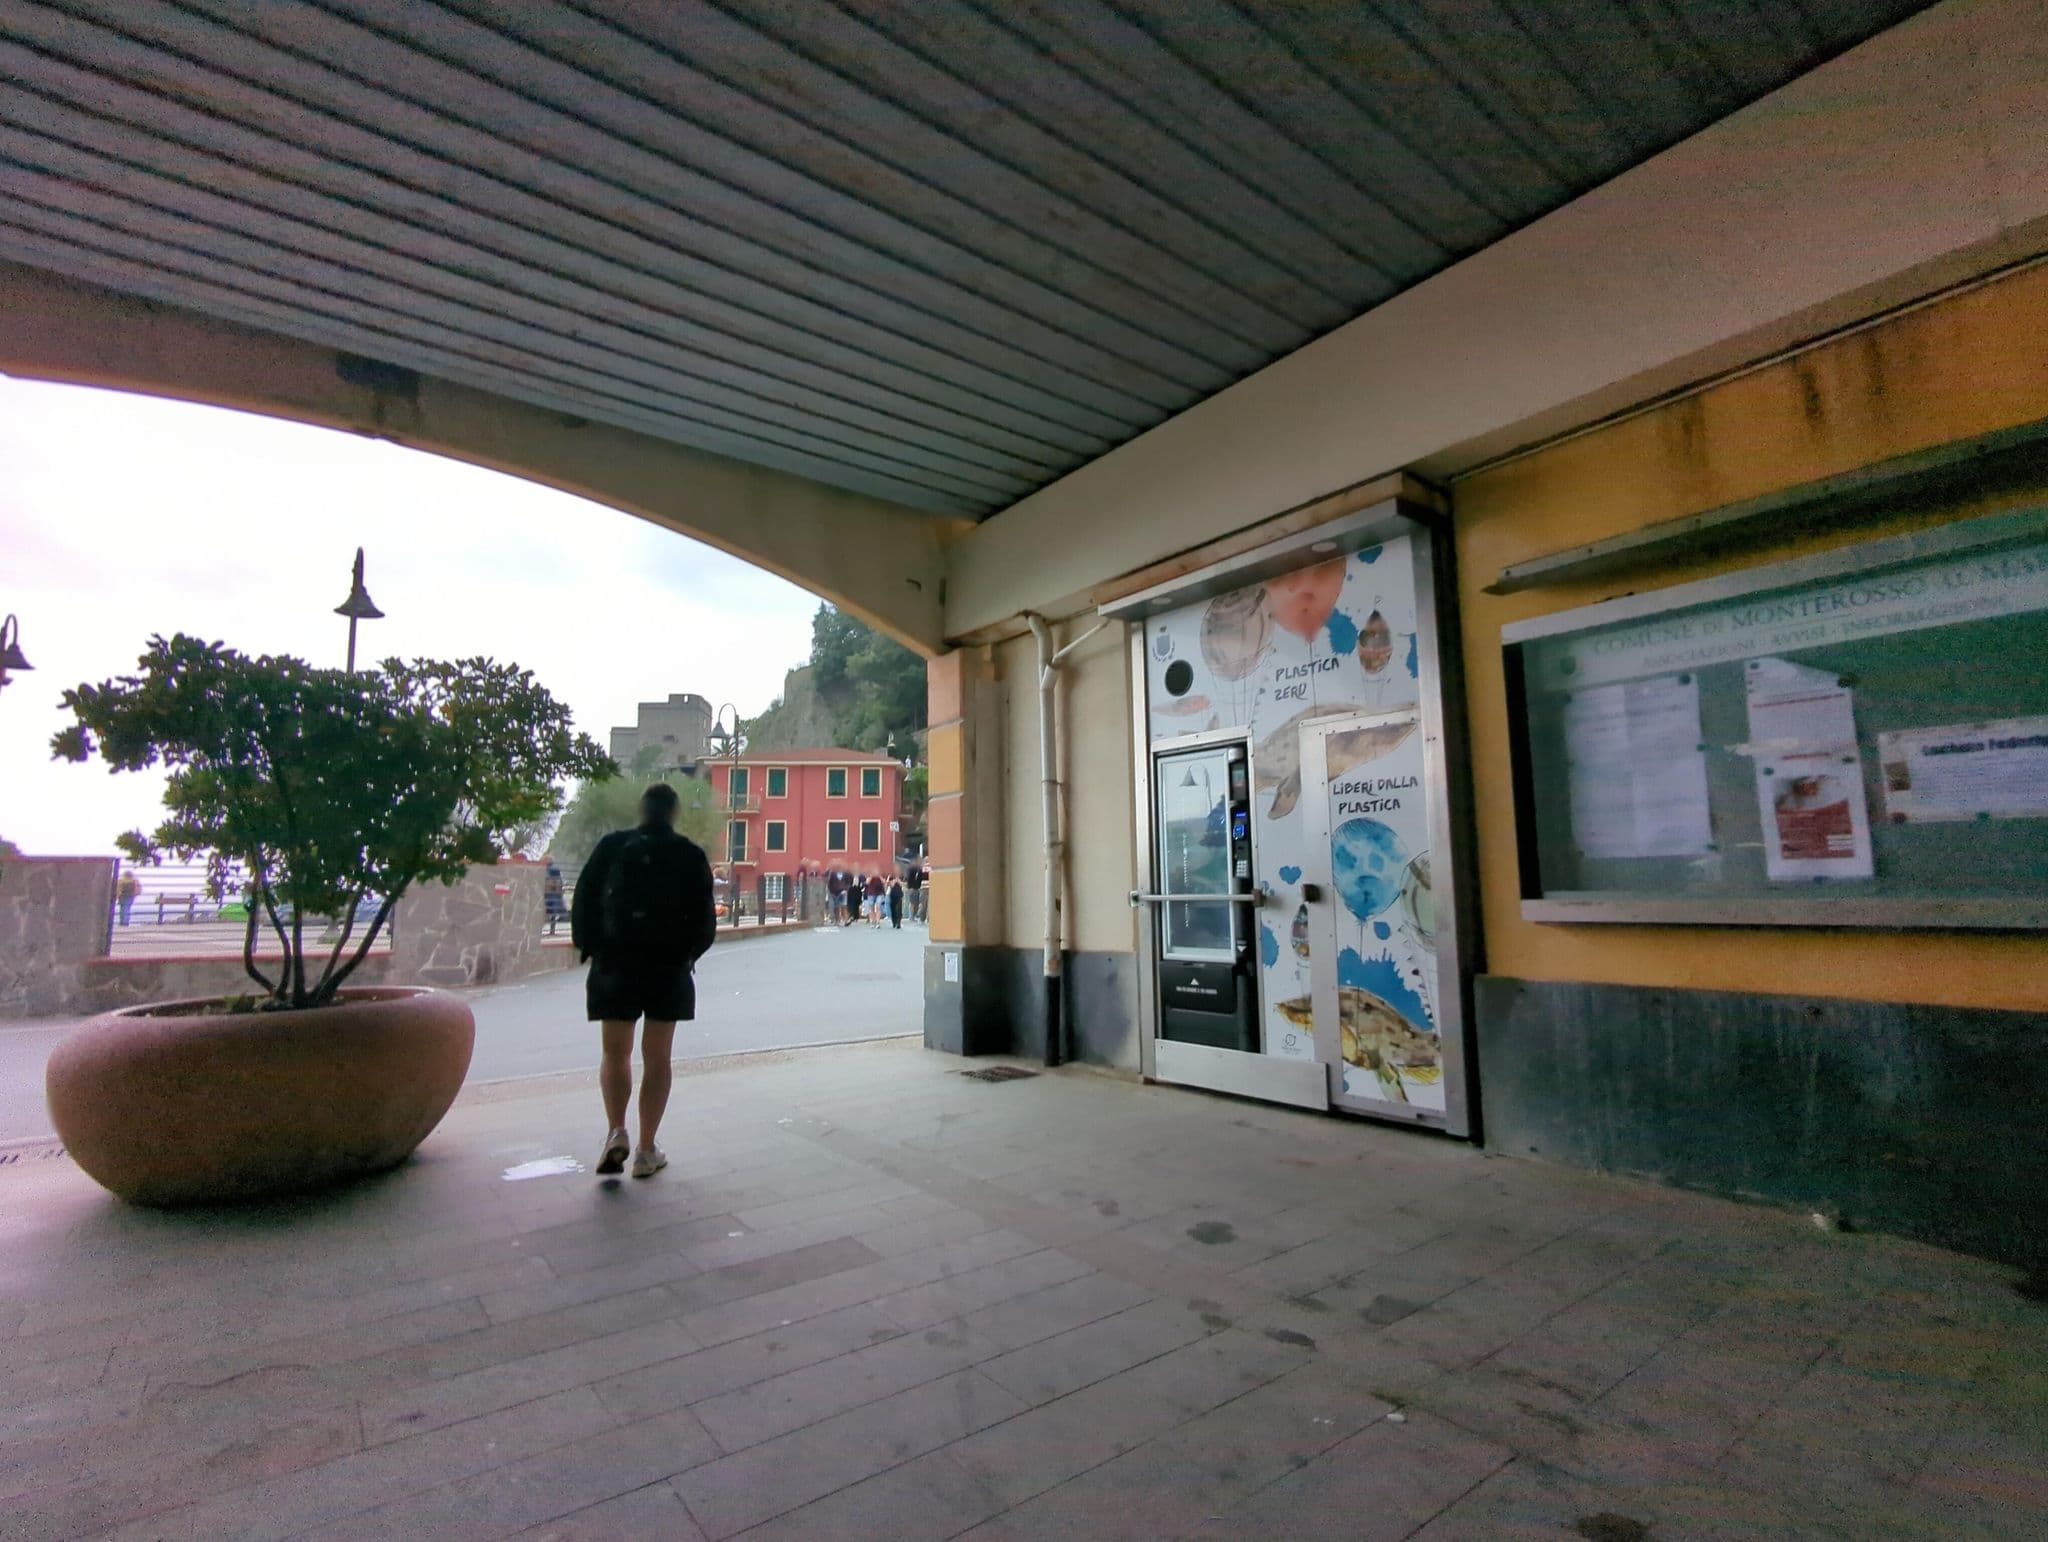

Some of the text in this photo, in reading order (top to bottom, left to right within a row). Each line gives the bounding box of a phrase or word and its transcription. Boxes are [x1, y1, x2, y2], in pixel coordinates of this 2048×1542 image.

[1593, 621, 1694, 656] COMUNE
[1731, 576, 1924, 627] MONTEROSSO
[1378, 776, 1418, 790] DALLA
